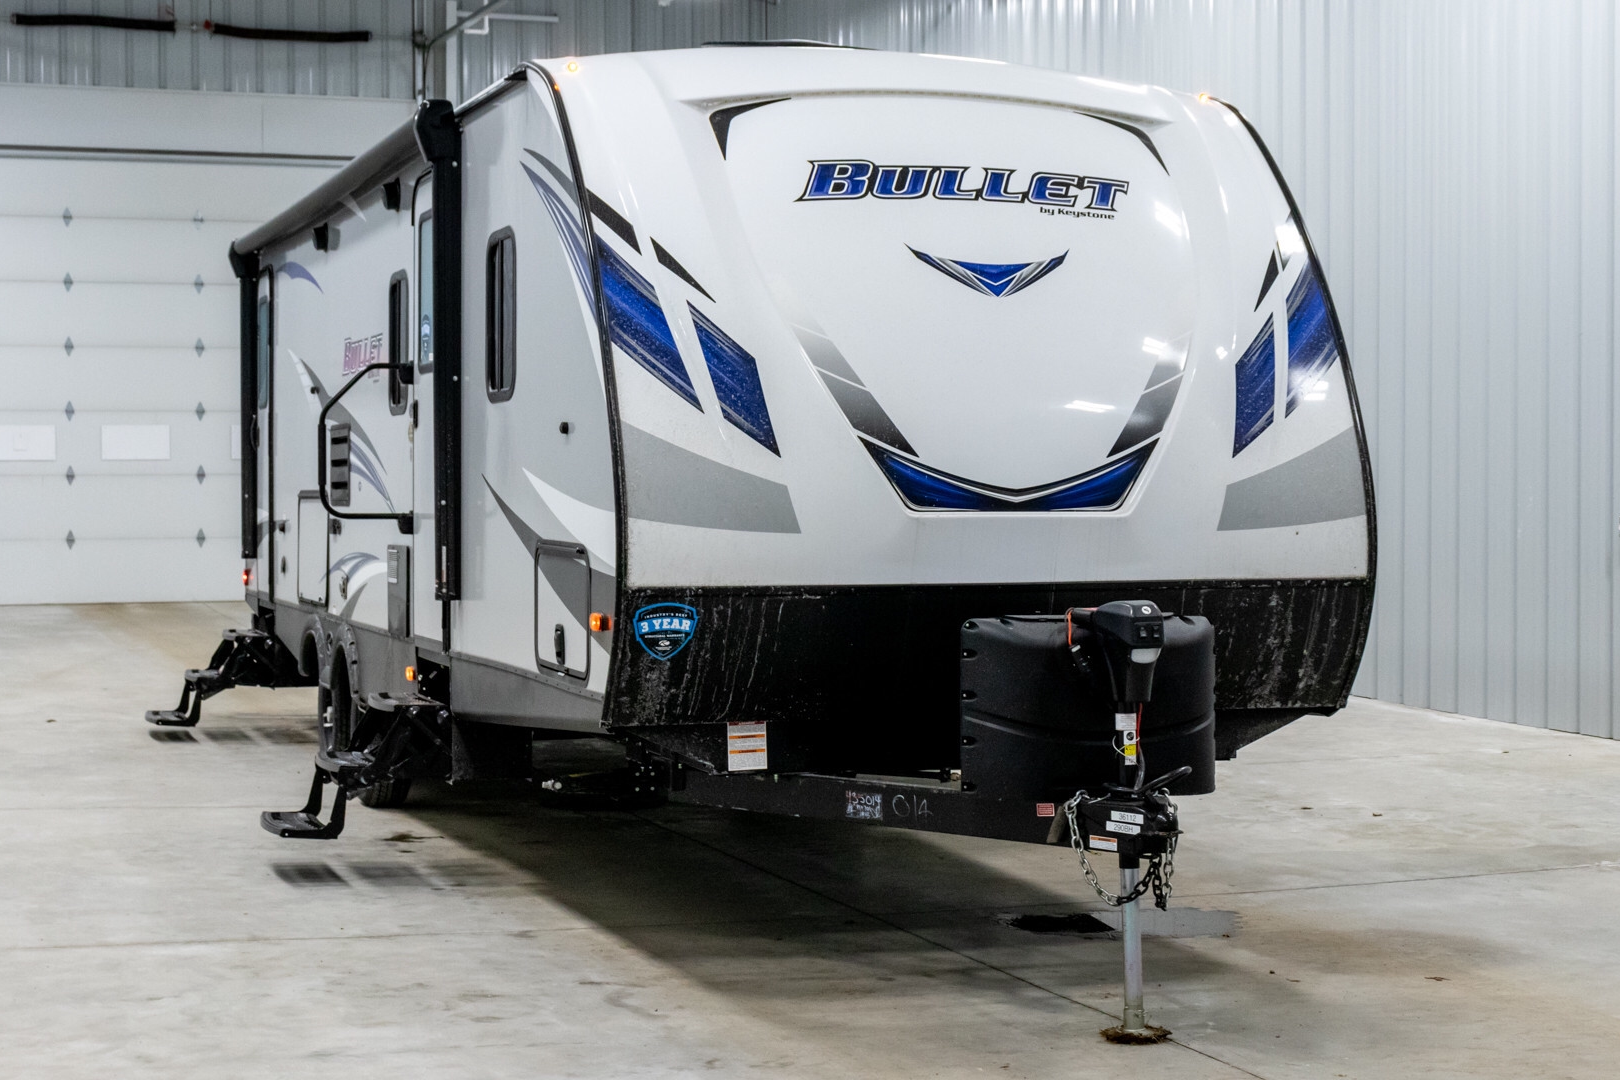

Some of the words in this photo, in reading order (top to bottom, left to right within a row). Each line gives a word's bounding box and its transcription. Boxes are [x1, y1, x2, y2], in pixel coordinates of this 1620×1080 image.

[793, 159, 1130, 211] BULLET
[1039, 206, 1054, 215] by
[1057, 208, 1115, 220] Keystone
[342, 332, 383, 376] BULLET
[640, 621, 649, 633] 3
[652, 618, 691, 631] YEAR
[1118, 812, 1137, 823] 36112
[1113, 823, 1134, 833] 290BH
